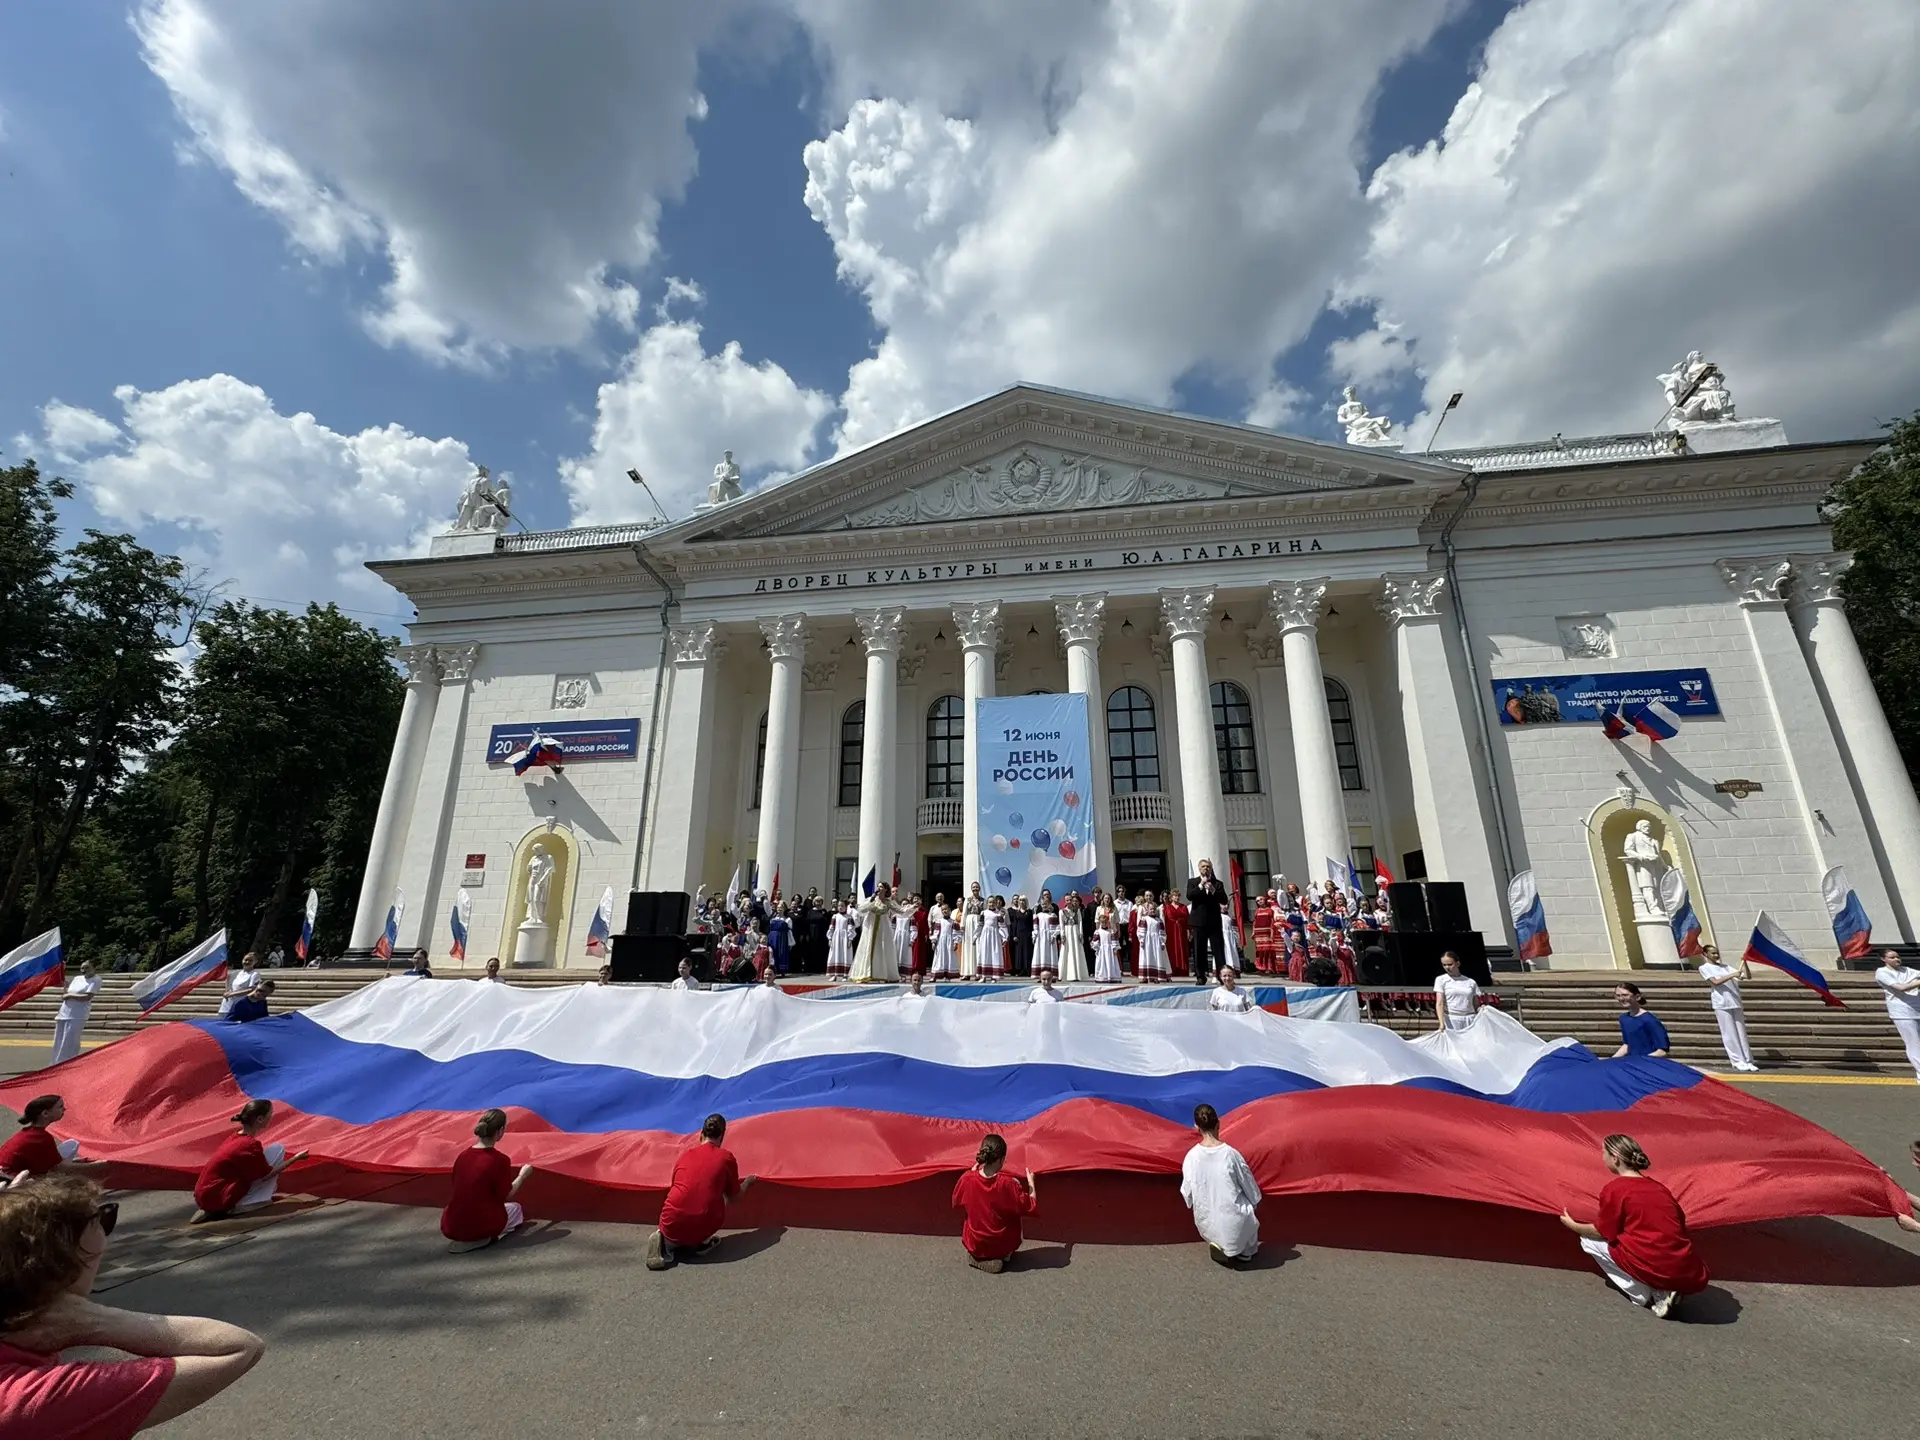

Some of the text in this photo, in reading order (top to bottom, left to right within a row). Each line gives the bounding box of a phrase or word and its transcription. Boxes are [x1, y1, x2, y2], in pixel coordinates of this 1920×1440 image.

[755, 574, 848, 592] ДВОРЕЦ
[867, 563, 997, 583] КУЛЬТУРЫ
[1025, 558, 1093, 571] ИМЕНИ
[1182, 538, 1322, 560] ГАГАРИНА
[1574, 691, 1619, 699] ЕДИНСТВО
[1003, 728, 1022, 742] 12
[1007, 749, 1059, 767] ДЕНЬ
[993, 765, 1074, 782] РОССИИ
